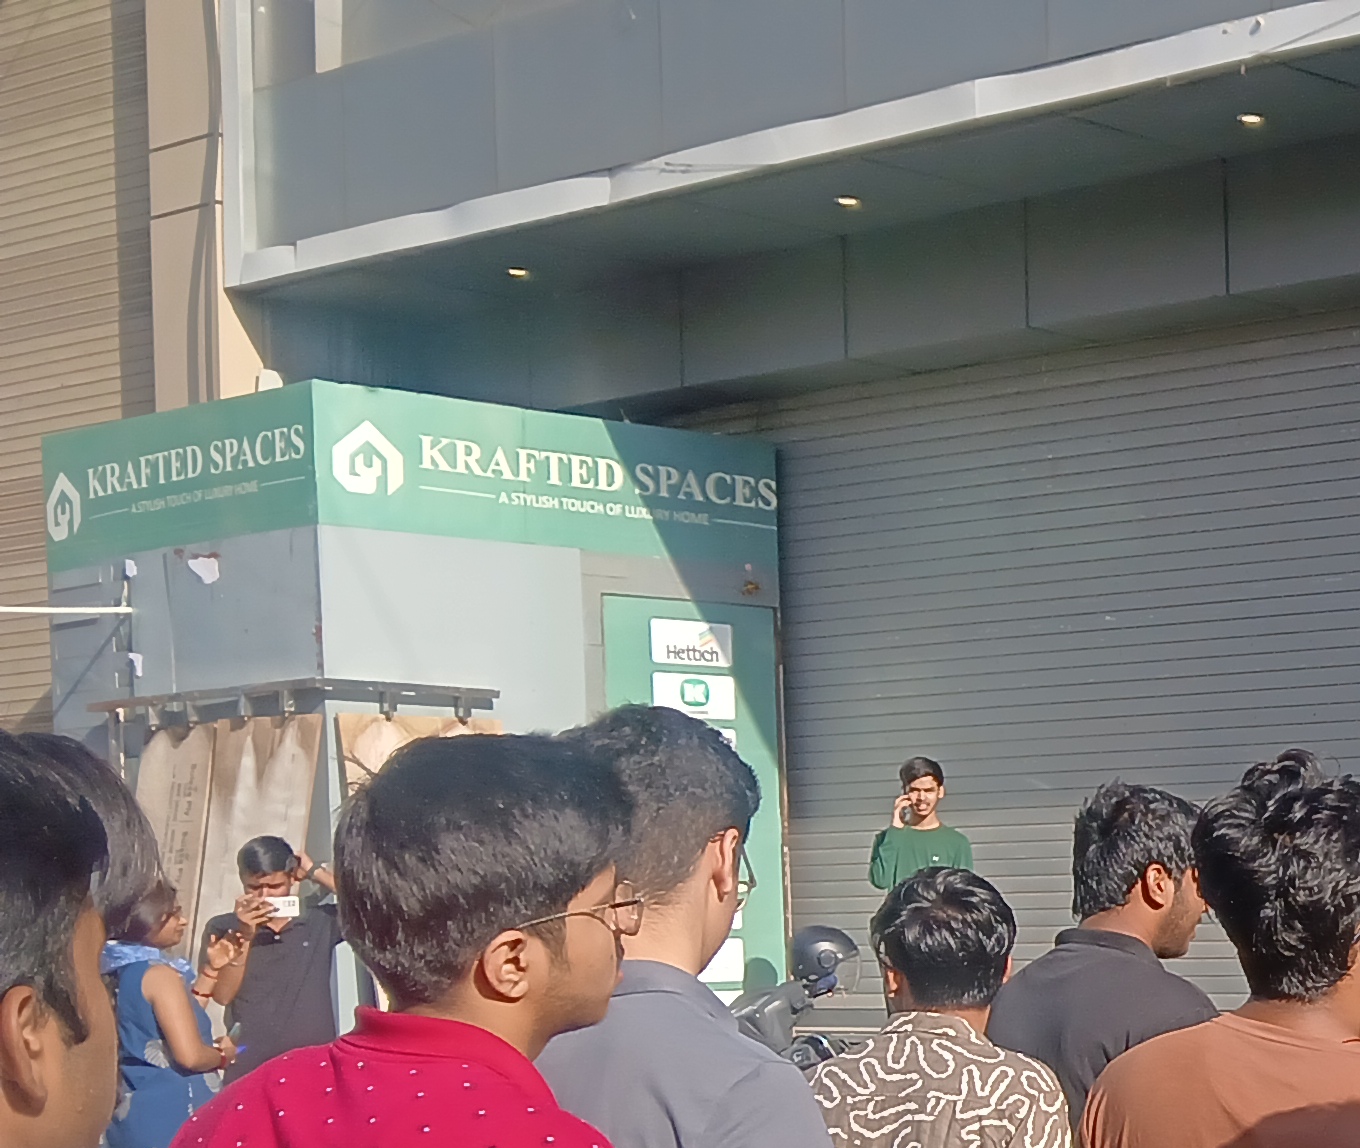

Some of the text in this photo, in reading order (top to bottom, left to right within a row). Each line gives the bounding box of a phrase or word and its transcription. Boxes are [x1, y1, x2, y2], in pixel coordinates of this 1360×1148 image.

[86, 424, 305, 499] KRAFTED SPACES
[419, 434, 778, 511] KRAFTED SPACES
[498, 491, 709, 525] A STYLISH TOUCH OF LUXURY HOME
[666, 645, 719, 662] Hettich
